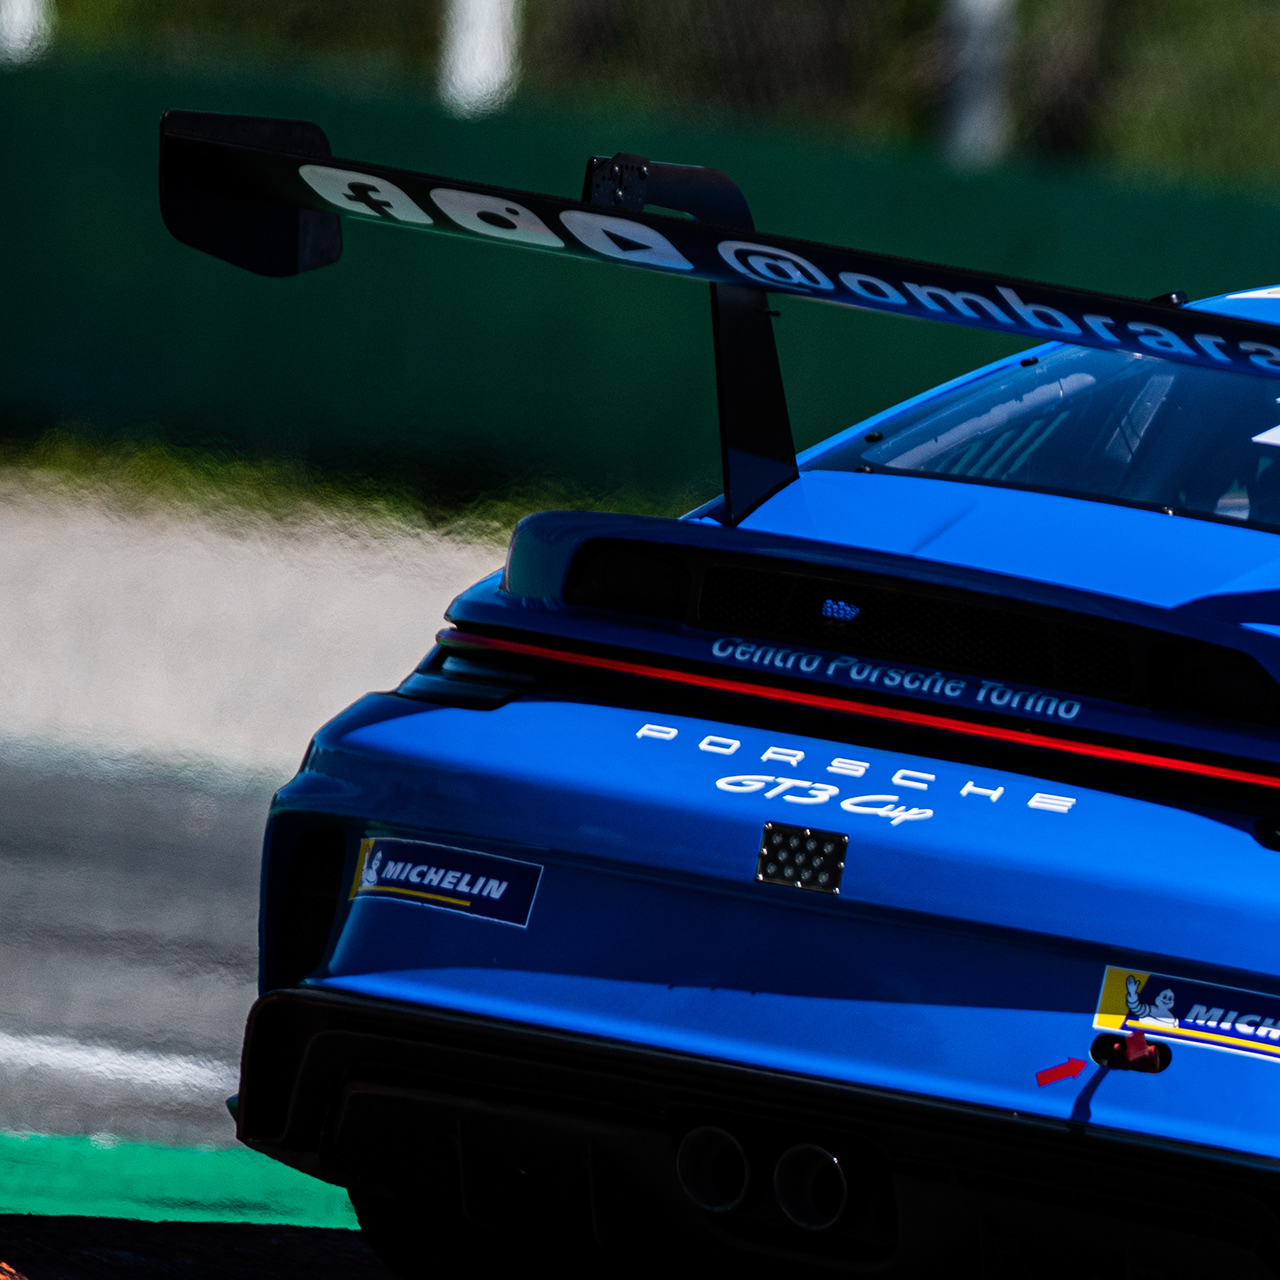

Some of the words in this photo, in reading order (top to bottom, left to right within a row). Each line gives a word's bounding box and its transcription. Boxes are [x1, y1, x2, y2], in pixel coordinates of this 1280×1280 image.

[712, 636, 820, 674] Centro
[826, 654, 966, 698] Porsche
[976, 679, 1082, 721] Torino
[635, 722, 1078, 814] PORSCHE
[715, 774, 840, 805] GT3
[840, 793, 935, 827] Cup
[380, 860, 509, 900] MICHELIN
